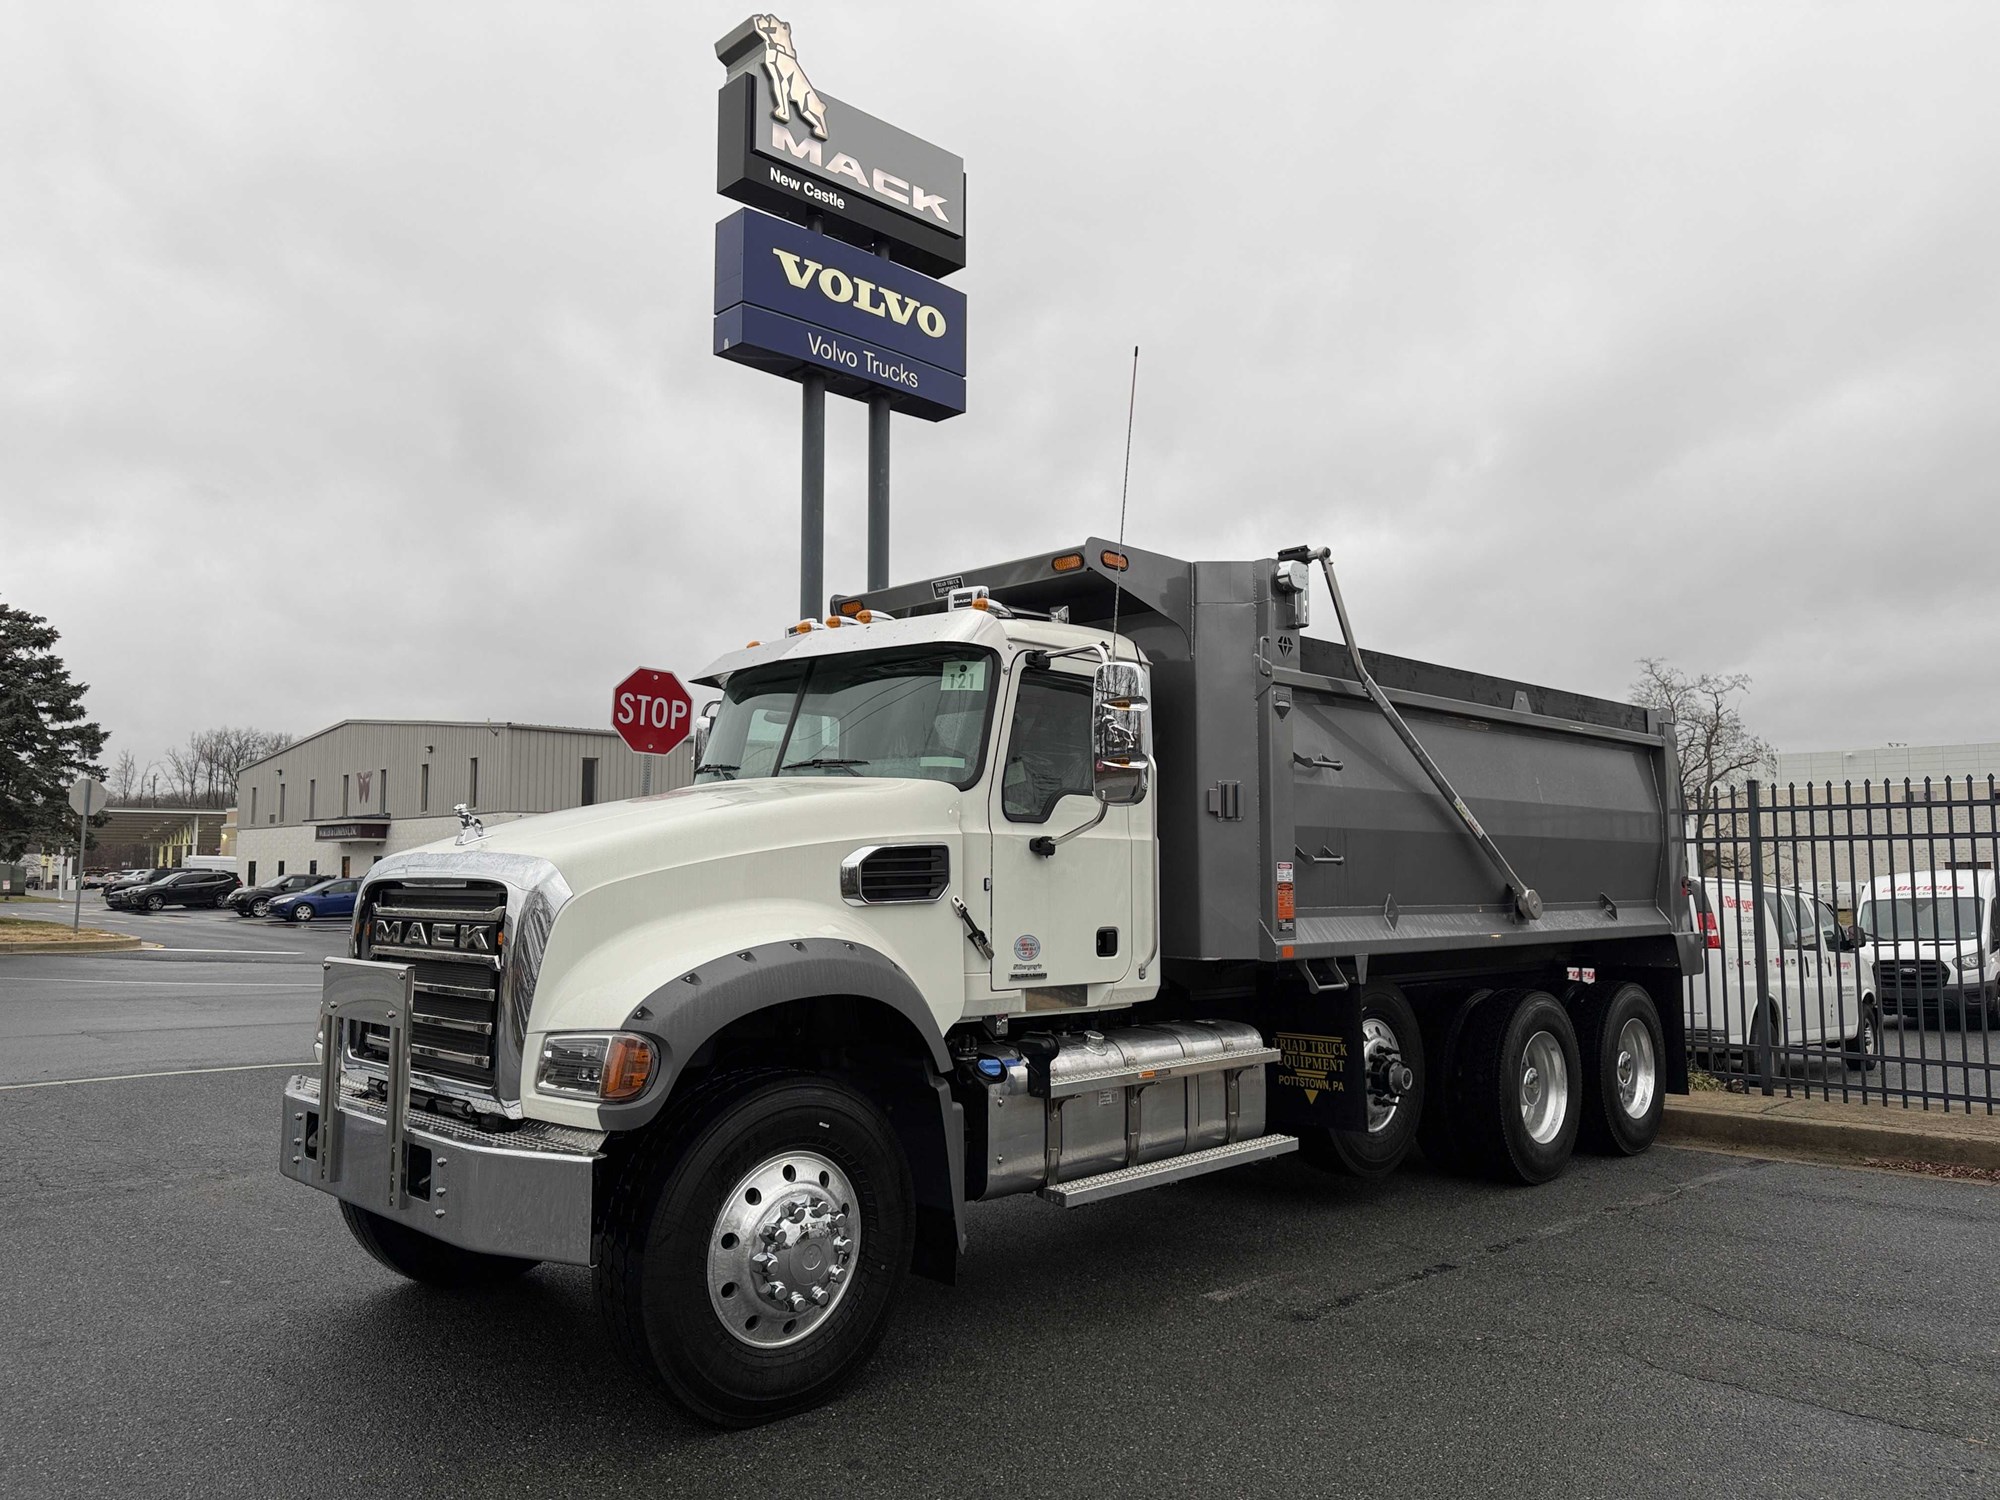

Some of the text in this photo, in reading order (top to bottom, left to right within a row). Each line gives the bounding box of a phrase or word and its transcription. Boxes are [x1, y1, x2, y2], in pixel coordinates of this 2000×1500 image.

[770, 166, 846, 210] New Castle
[772, 122, 949, 223] MACK
[772, 247, 947, 339] VOLVO
[807, 331, 919, 389] Volvo Trucks
[950, 673, 975, 689] 121
[617, 692, 688, 730] STOP
[375, 920, 490, 950] MACK
[1272, 1037, 1348, 1057] TRIAD TRUCK
[1278, 1075, 1345, 1092] POTTSTOWN, PA
